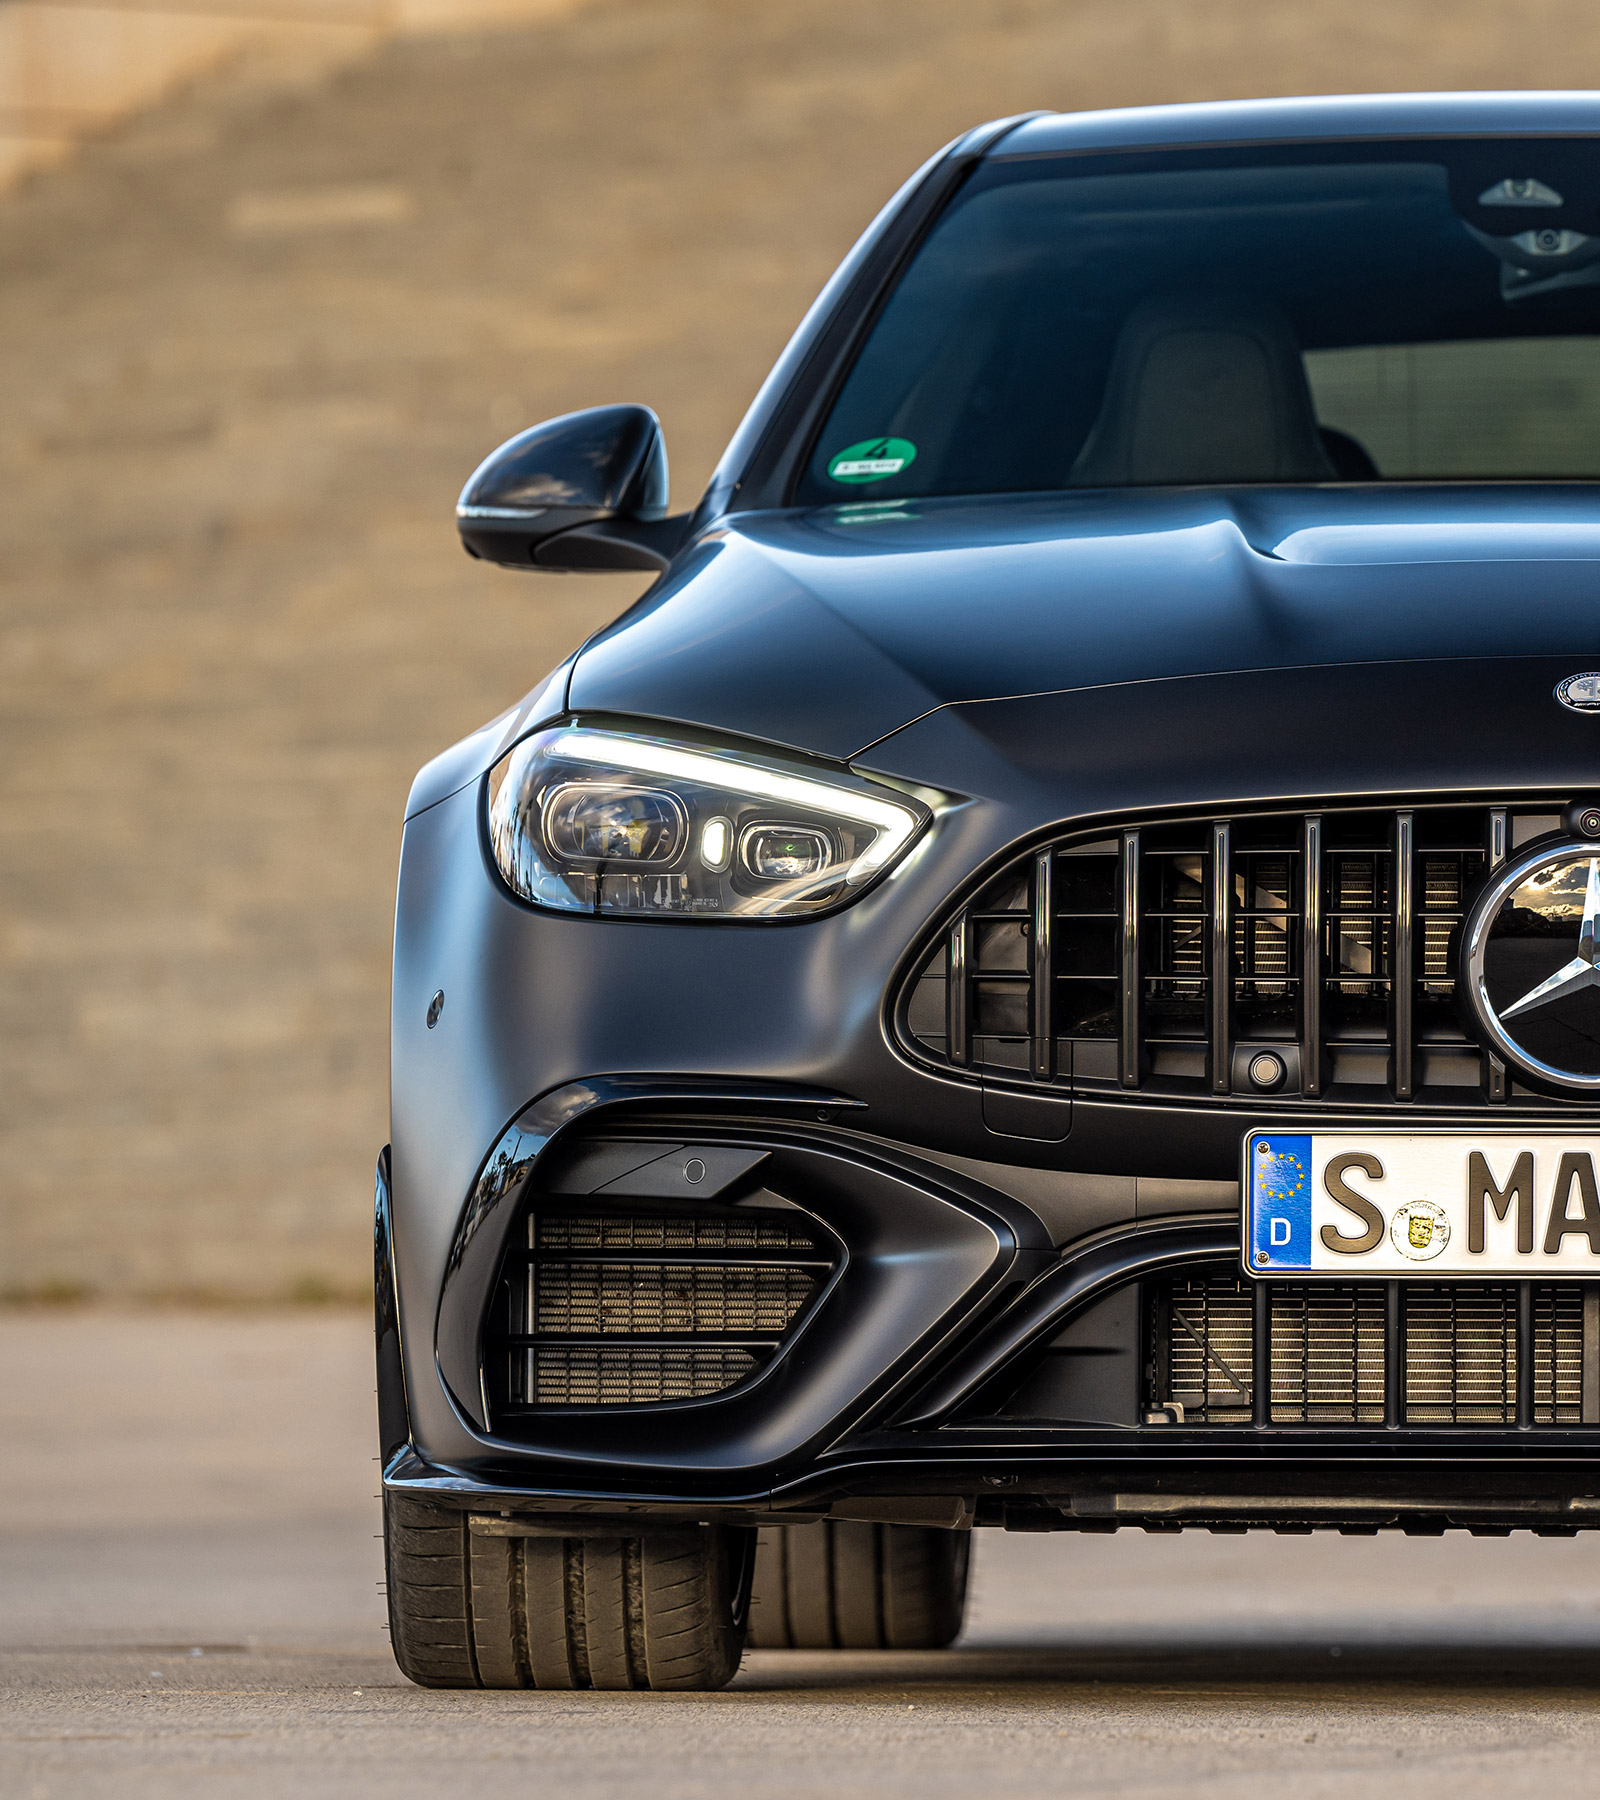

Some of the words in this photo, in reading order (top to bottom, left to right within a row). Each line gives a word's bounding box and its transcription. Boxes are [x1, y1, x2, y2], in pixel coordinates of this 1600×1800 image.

[864, 438, 889, 459] 4
[1320, 1151, 1385, 1254] S
[1270, 1217, 1291, 1246] D
